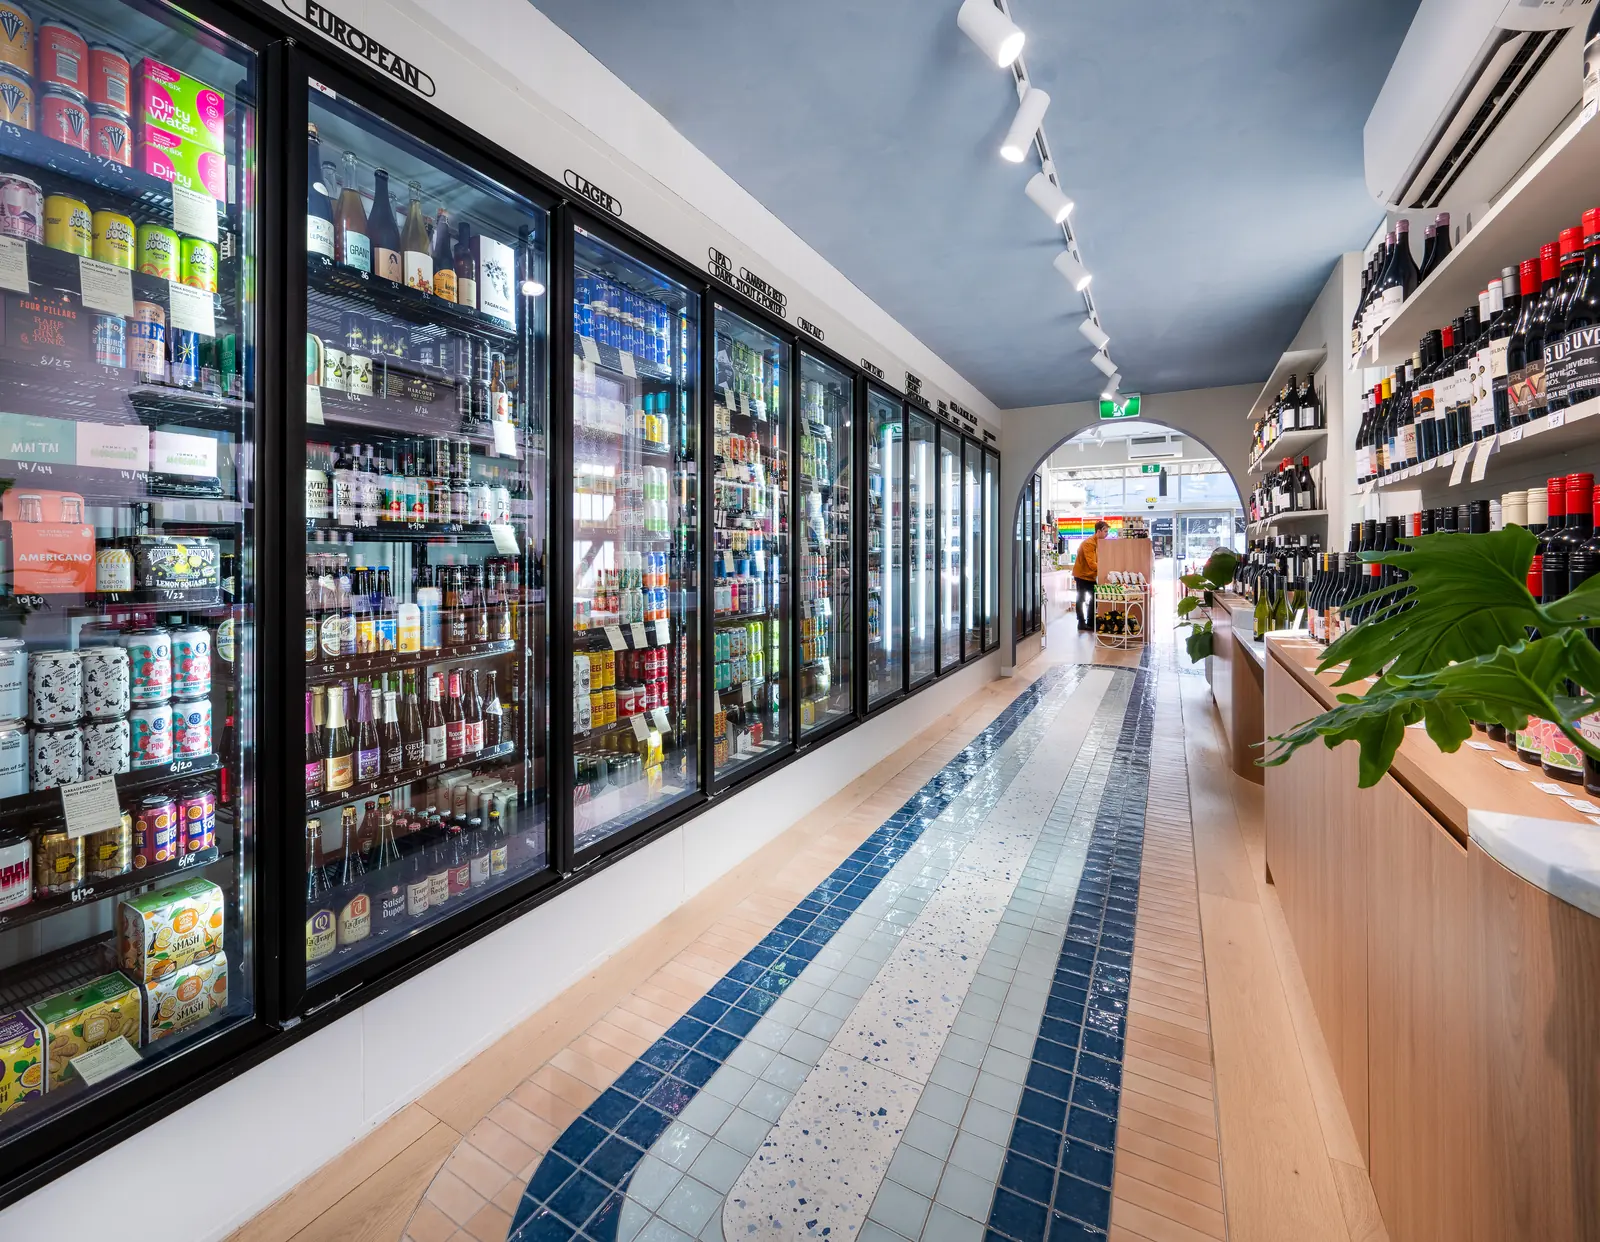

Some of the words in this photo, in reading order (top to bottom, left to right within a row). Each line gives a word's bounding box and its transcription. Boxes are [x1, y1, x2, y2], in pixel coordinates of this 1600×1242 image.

[306, 2, 419, 89] EUROPEAN
[152, 96, 190, 124] Dirty
[149, 107, 198, 136] Water.
[153, 162, 191, 188] Dirty
[575, 175, 613, 212] LAGER
[715, 250, 727, 268] IPA
[746, 272, 767, 291] AMBER
[773, 289, 783, 303] RED
[736, 278, 756, 298] STOUT
[762, 295, 782, 317] PORTER
[20, 299, 40, 311] FOUR
[44, 305, 77, 319] PILLARS
[802, 319, 812, 334] PALE
[40, 355, 72, 368] 8/25
[11, 442, 35, 453] MAI
[38, 440, 59, 453] TAI
[19, 553, 92, 561] AMERICANO
[188, 549, 211, 559] UNION
[156, 579, 180, 588] LEMON
[181, 578, 207, 588] SQUASH
[170, 761, 193, 771] 6/20
[83, 782, 101, 790] PROJECT
[172, 934, 200, 953] SMASH
[176, 1002, 204, 1021] SMASH
